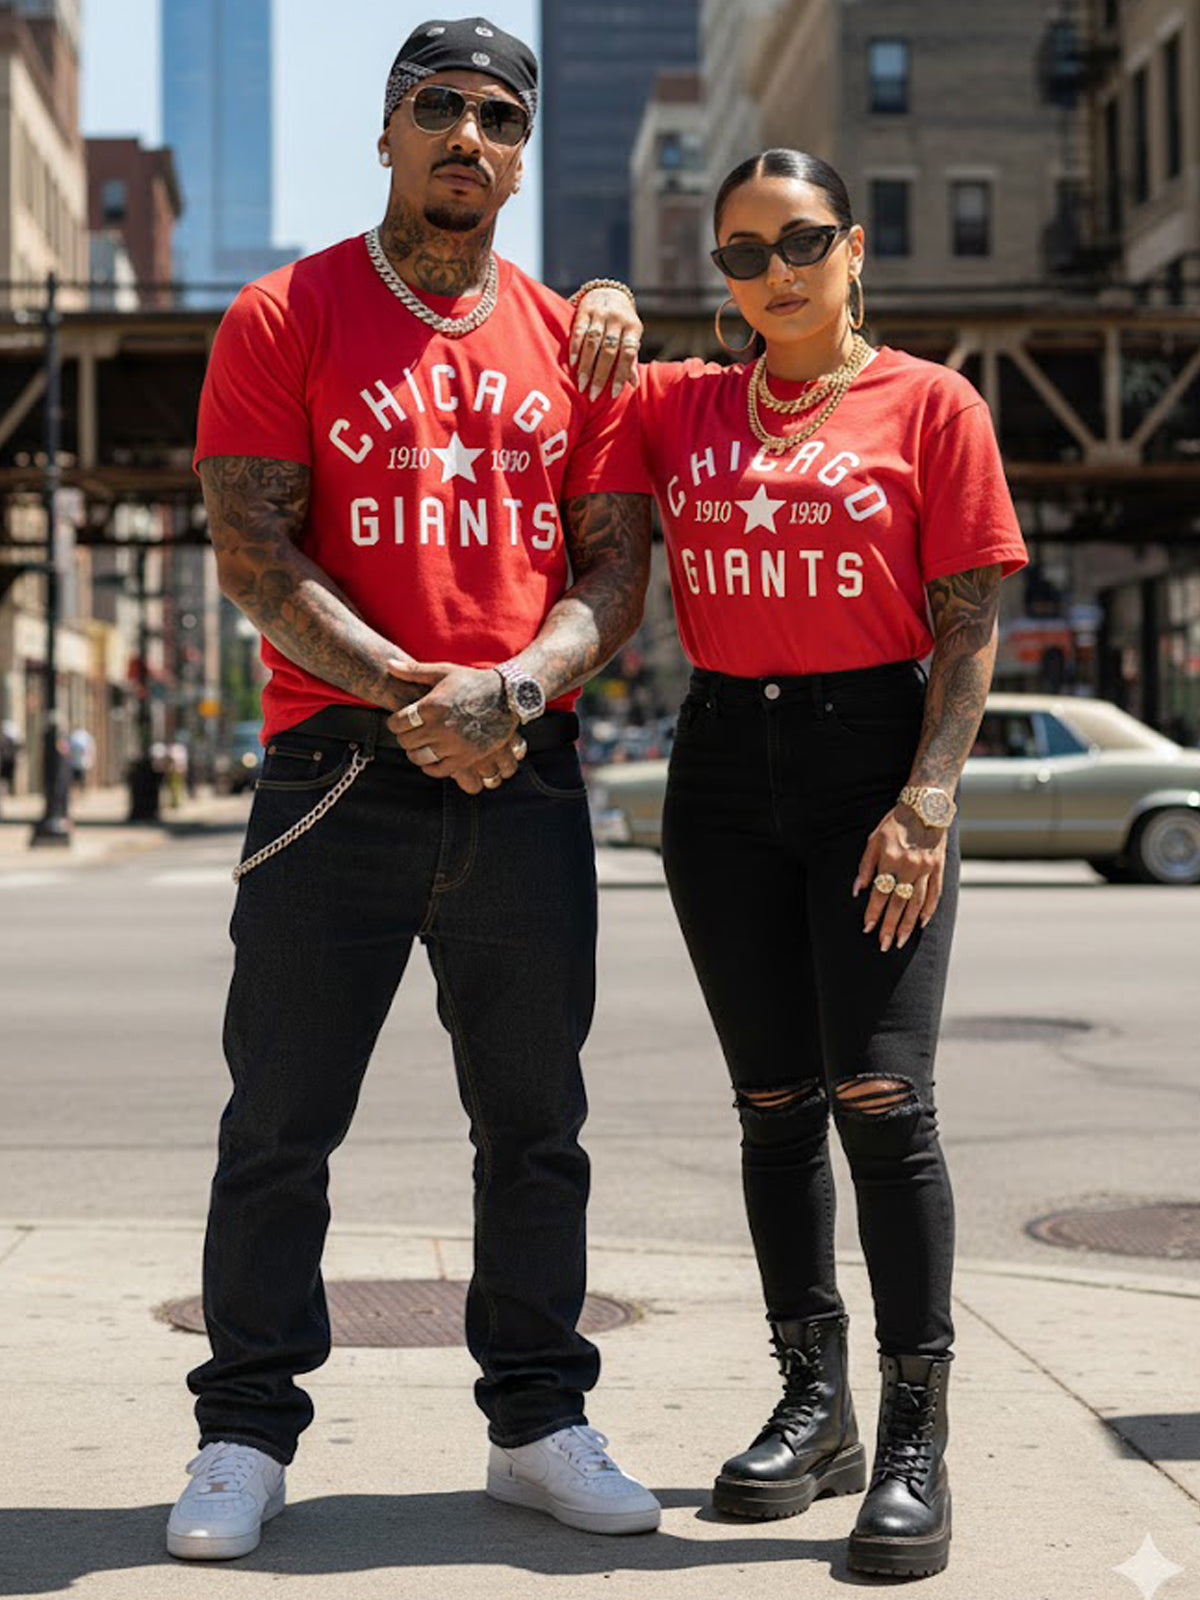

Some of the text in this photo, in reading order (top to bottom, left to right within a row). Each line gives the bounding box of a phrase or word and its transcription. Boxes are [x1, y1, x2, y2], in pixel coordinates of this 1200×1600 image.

[329, 364, 568, 466] CHICAGO
[387, 447, 430, 470] 1910
[351, 497, 557, 549] GIANTS
[694, 501, 832, 524] 1910 1930
[682, 548, 864, 597] GIANTS
